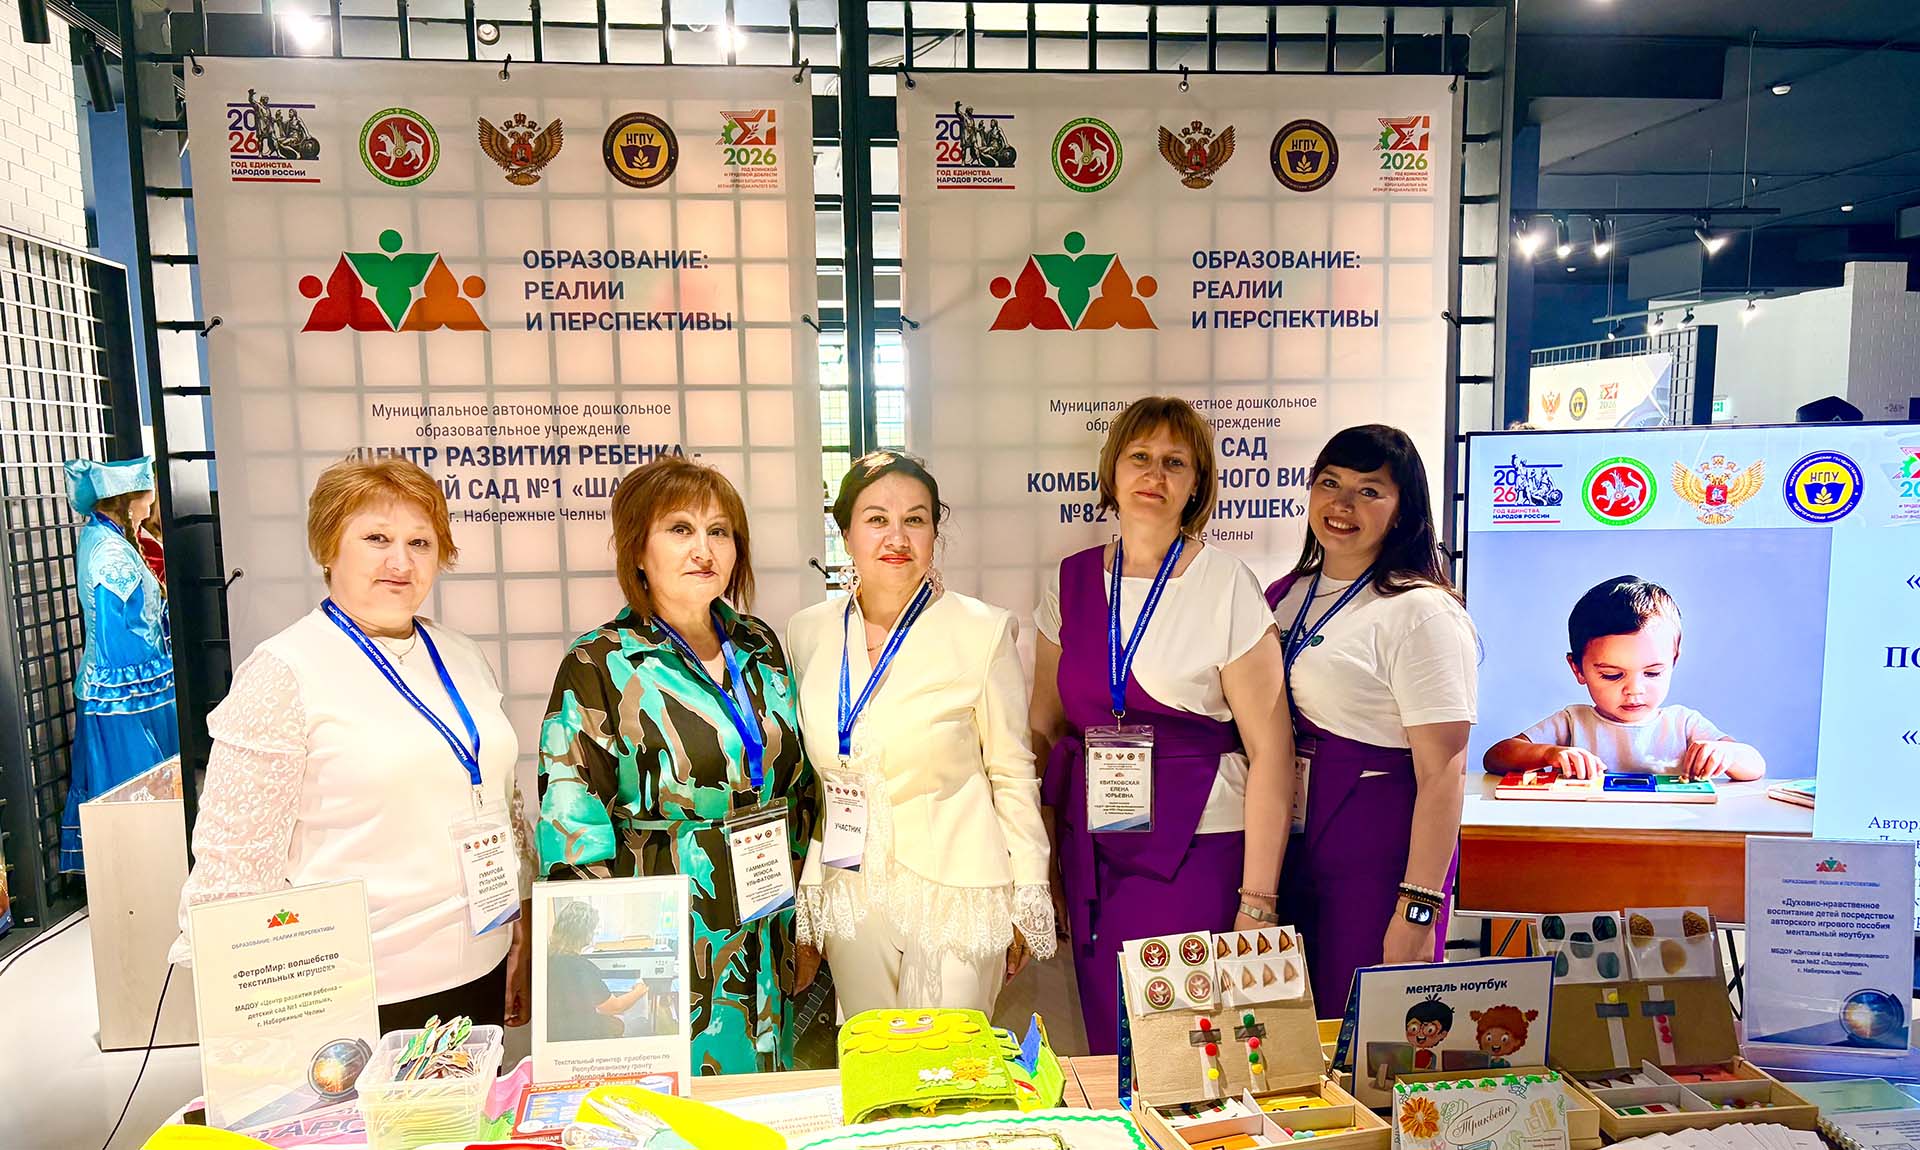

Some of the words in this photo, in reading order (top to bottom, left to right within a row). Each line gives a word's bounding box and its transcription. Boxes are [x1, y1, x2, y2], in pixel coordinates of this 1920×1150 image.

[227, 109, 256, 131] 20
[935, 119, 961, 141] 20
[229, 132, 259, 153] 26
[626, 133, 654, 145] НГПУ
[1291, 139, 1318, 151] НГПУ
[723, 148, 777, 166] 2026
[935, 142, 962, 162] 26
[231, 161, 247, 169] ГОД
[249, 161, 292, 169] ЕДИНСТВА
[1380, 152, 1428, 170] 2026
[272, 169, 306, 177] РОССИИ
[523, 250, 709, 269] ОБРАЗОВАНИЕ:
[1192, 250, 1361, 269] ОБРАЗОВАНИЕ:
[524, 281, 624, 300] РЕАЛИИ
[1192, 280, 1283, 299] РЕАЛИИ
[526, 312, 542, 331] И
[550, 312, 732, 331] ПЕРСПЕКТИВЫ
[1191, 311, 1207, 329] И
[1214, 310, 1379, 329] ПЕРСПЕКТИВЫ
[372, 404, 488, 420] Муниципальное
[492, 404, 578, 416] автономное
[582, 403, 671, 417] дошкольное
[1236, 397, 1317, 411] дошкольное
[416, 423, 540, 439] образовательное
[544, 423, 630, 438] учреждение
[1206, 417, 1281, 431] чреждение
[446, 445, 571, 466] РАЗВИТИЯ
[1221, 437, 1268, 461] САД
[1493, 470, 1518, 486] 20
[1810, 472, 1839, 482] НГПУ
[468, 478, 520, 503] САД
[527, 477, 562, 499] №1
[1493, 487, 1516, 502] 26
[1900, 481, 1920, 497] 20
[450, 512, 459, 522] г.
[464, 508, 555, 524] Набережные
[559, 508, 606, 521] Челны
[1060, 503, 1107, 523] №82
[1212, 529, 1254, 541] Челны
[834, 822, 861, 834] УЧАСТНИК
[1868, 816, 1920, 833] Автор
[1782, 898, 1880, 909] «Духовно-нравственное
[1815, 910, 1839, 918] детей
[1841, 912, 1894, 920] посредством
[1786, 929, 1837, 937] ментальный
[1838, 931, 1875, 940] ноутбук»
[1856, 922, 1890, 930] пособия
[233, 963, 286, 979] «ФетроМир:
[287, 952, 339, 968] волшебство
[238, 972, 295, 990] текстильных
[296, 964, 336, 978] игрушек»
[1406, 982, 1457, 995] менталь
[1460, 978, 1508, 993] ноутбук
[235, 1001, 259, 1012] МАДОУ
[248, 1008, 273, 1020] детский
[274, 1006, 286, 1014] сад
[263, 1013, 303, 1026] Набережные
[304, 1007, 326, 1016] Челны
[554, 1058, 594, 1066] Текстильный
